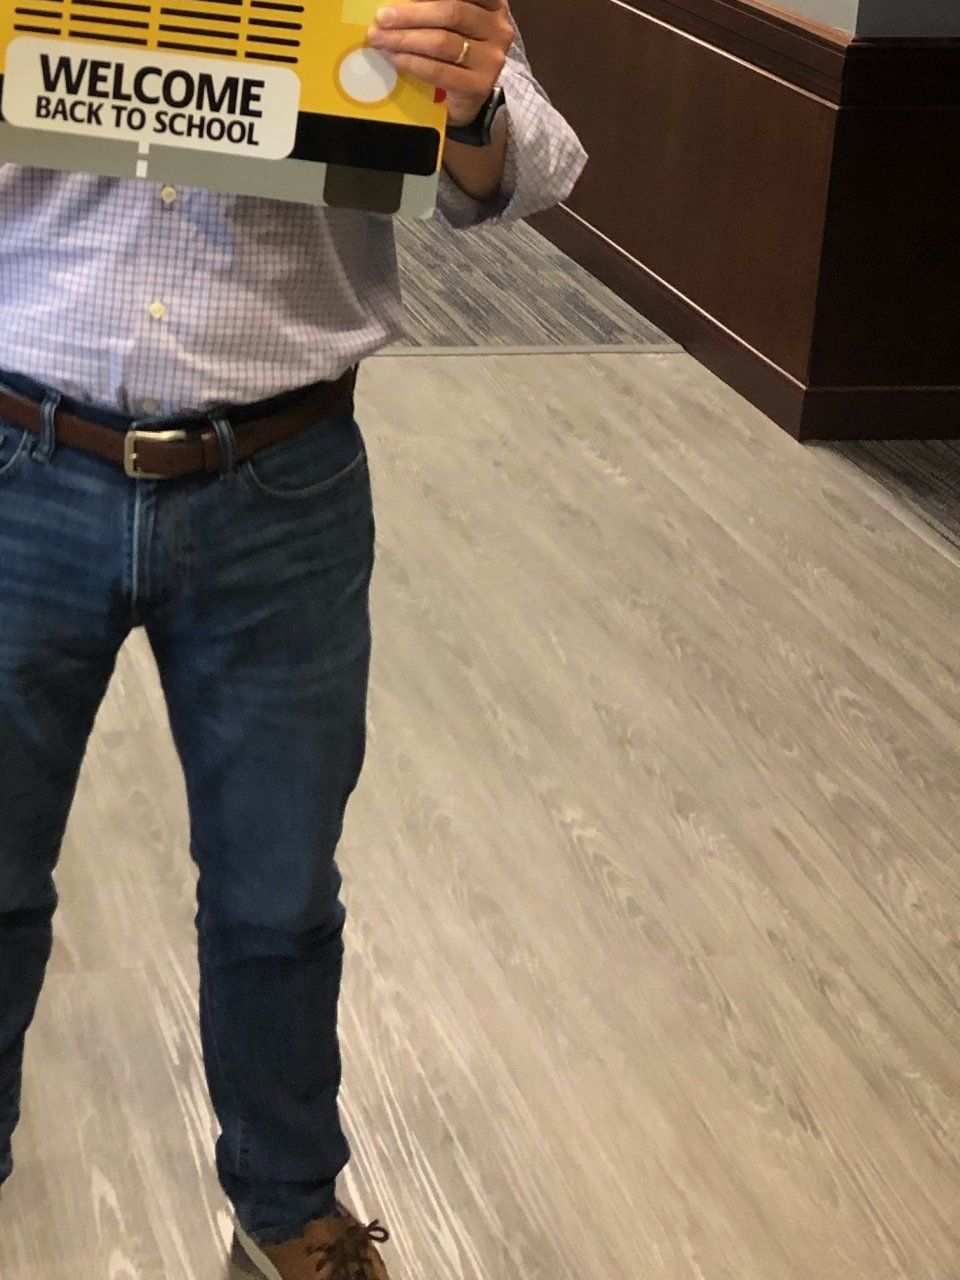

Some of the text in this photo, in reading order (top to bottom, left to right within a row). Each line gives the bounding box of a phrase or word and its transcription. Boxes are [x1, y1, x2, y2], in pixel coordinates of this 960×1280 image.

[40, 53, 265, 118] WELCOME
[35, 95, 259, 146] BACK TO SCHOOL
